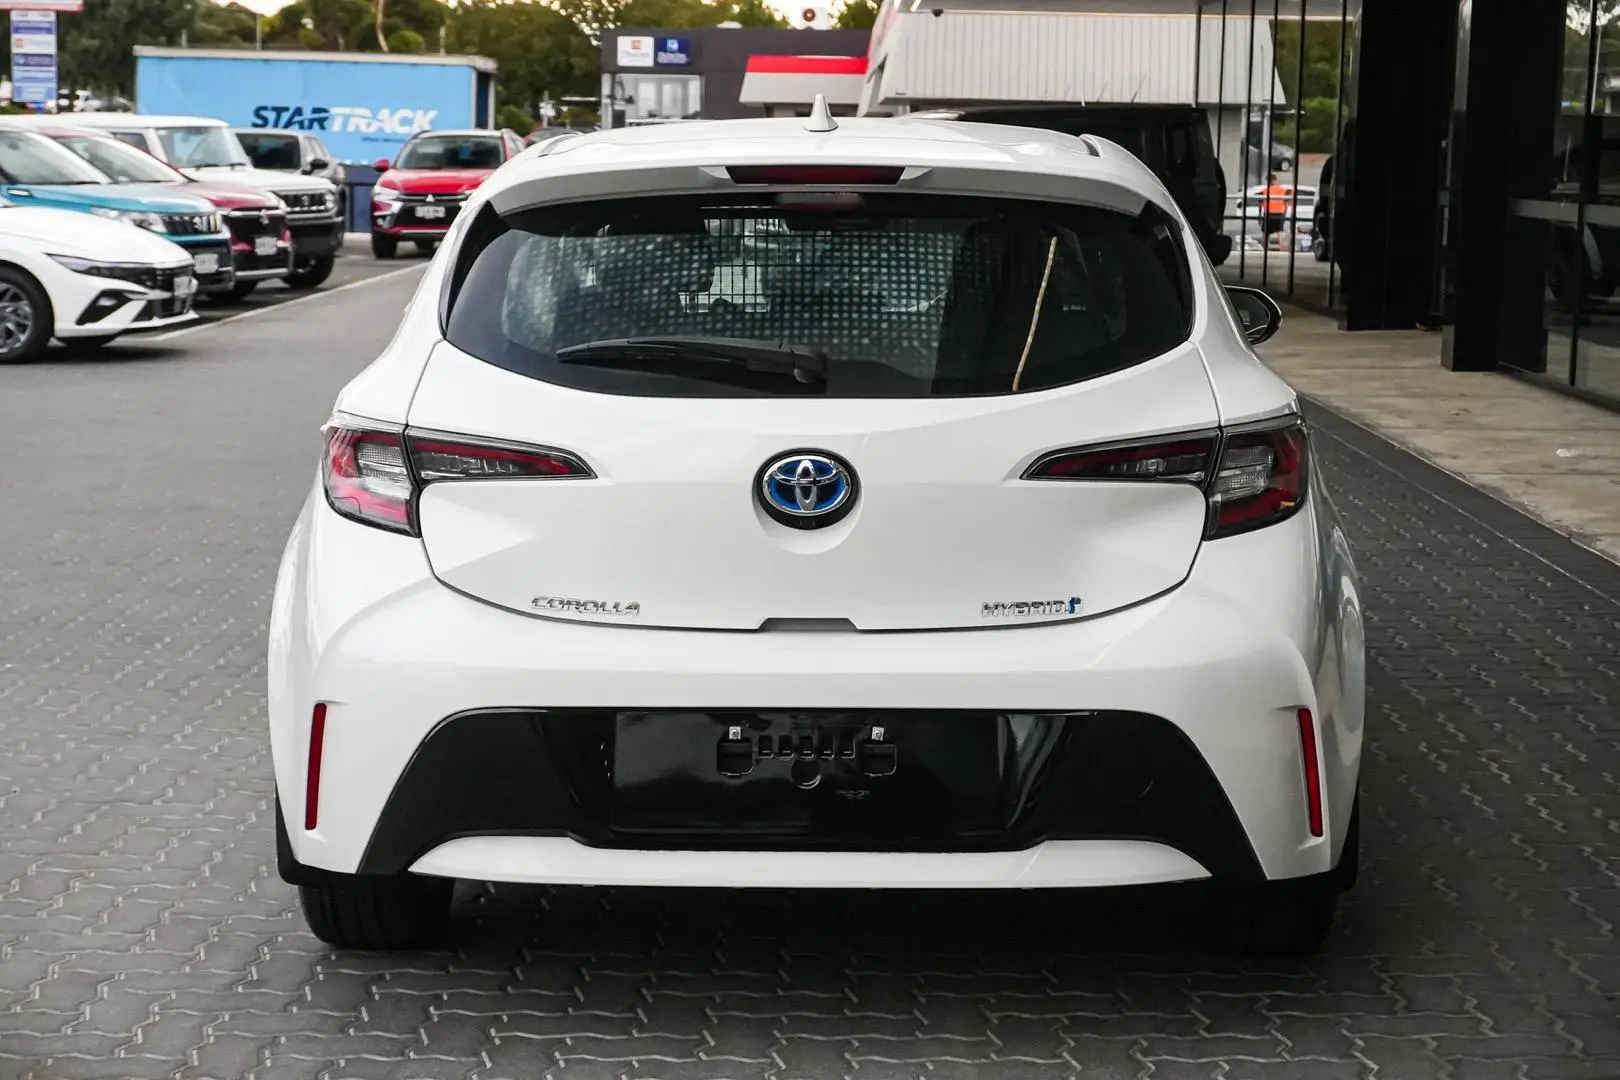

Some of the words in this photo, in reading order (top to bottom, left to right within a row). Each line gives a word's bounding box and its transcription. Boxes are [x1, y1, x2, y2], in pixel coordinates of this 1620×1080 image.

[252, 106, 438, 133] STARTRACK
[531, 596, 640, 615] COROLLA
[982, 600, 1066, 617] HYBRID
